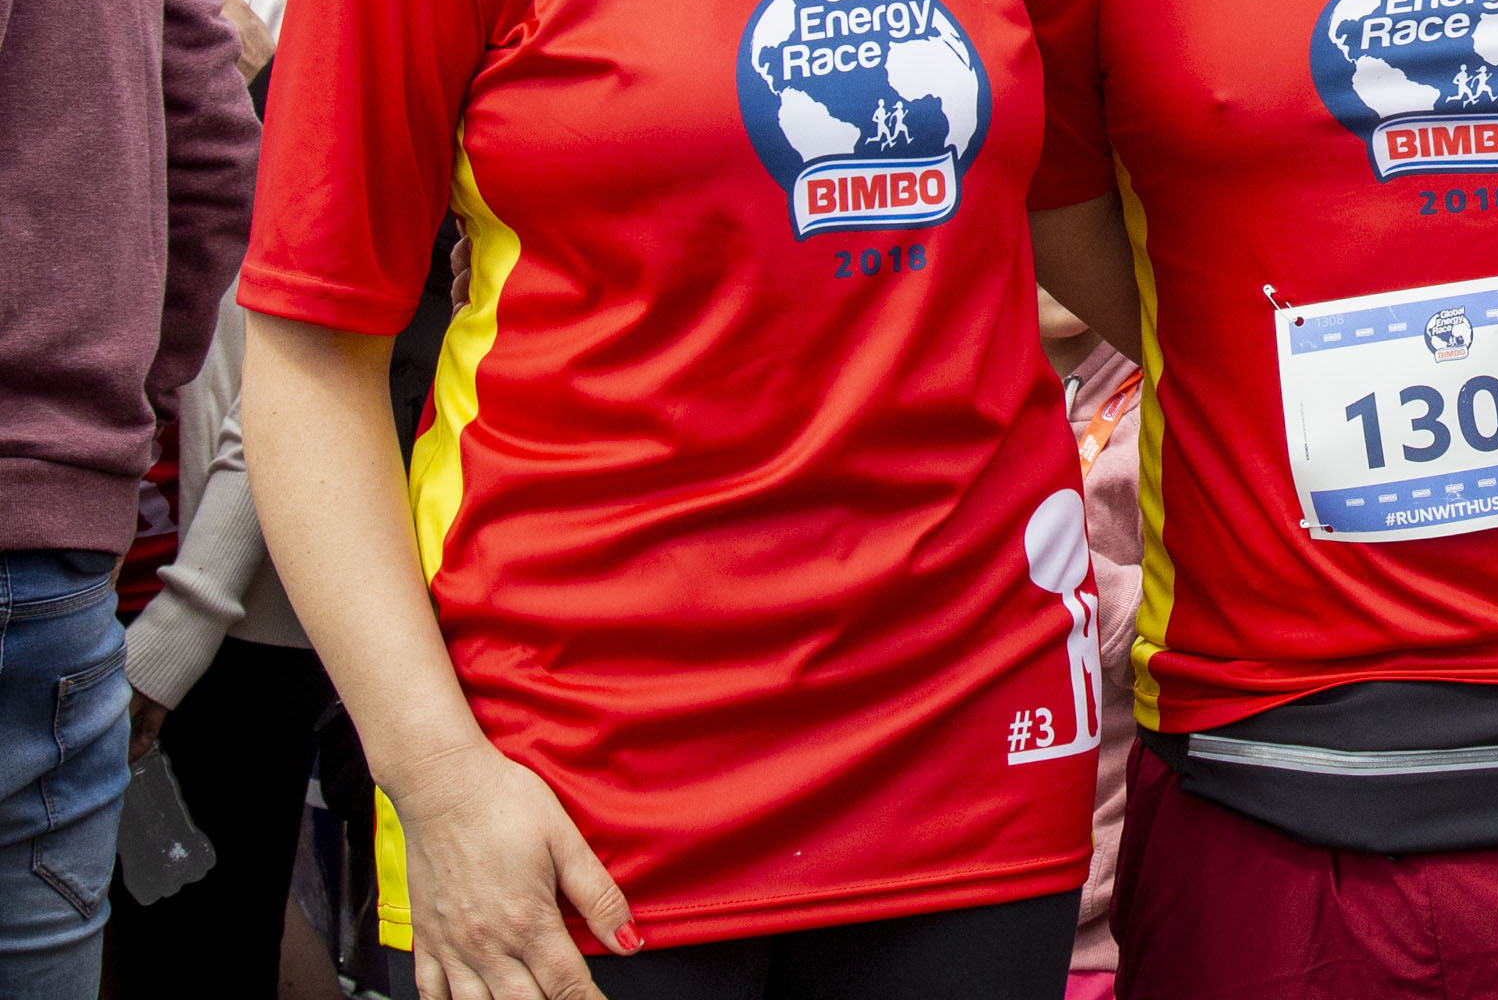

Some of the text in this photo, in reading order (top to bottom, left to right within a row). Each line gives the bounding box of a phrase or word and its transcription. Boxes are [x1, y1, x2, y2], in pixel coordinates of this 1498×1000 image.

[800, 0, 931, 41] Energy
[1360, 13, 1471, 50] Race
[782, 40, 882, 81] Race
[807, 169, 946, 215] BIMBO
[834, 245, 927, 278] 2018
[1436, 315, 1464, 326] Energy
[1440, 306, 1465, 319] Global
[1007, 707, 1055, 752] #3
